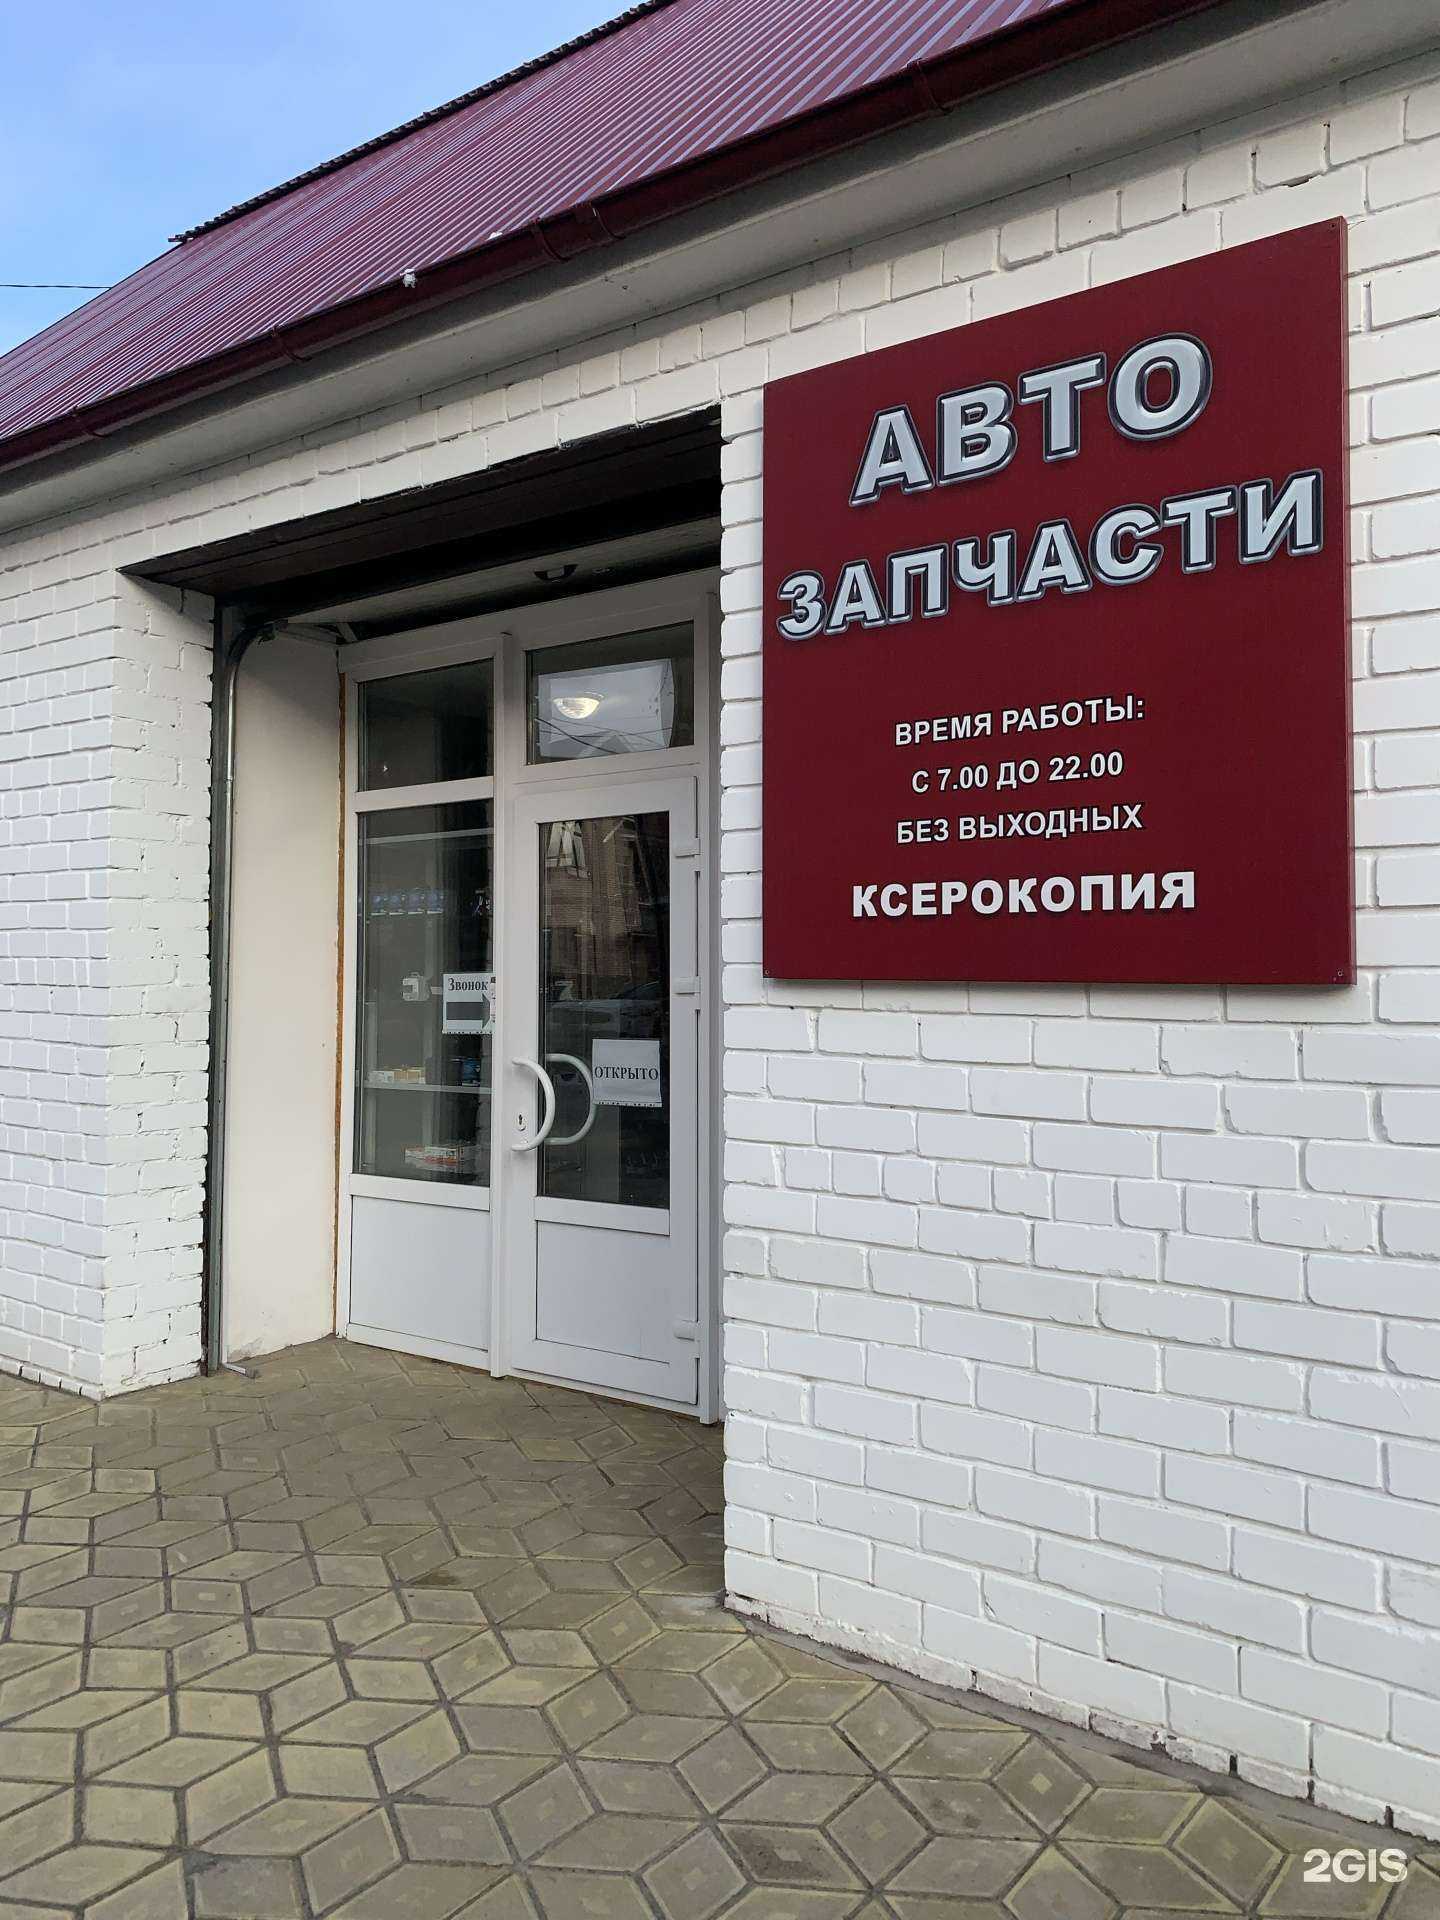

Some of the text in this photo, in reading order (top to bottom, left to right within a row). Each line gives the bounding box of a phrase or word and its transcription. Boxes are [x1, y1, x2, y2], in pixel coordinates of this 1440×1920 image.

[849, 332, 1213, 508] АВТО
[777, 468, 1323, 641] ЗАПЧАСТИ
[894, 695, 1145, 746] ВРЕМЯ РАБОТЫ:
[911, 751, 1123, 794] С 7.00 ДО 22.00
[896, 804, 1143, 844] БЕЗ ВЫХОДНЫХ
[852, 871, 1195, 918] КСЕРОКОПИЯ
[447, 977, 489, 991] Звонок
[594, 1066, 659, 1080] ОТКРЫТО
